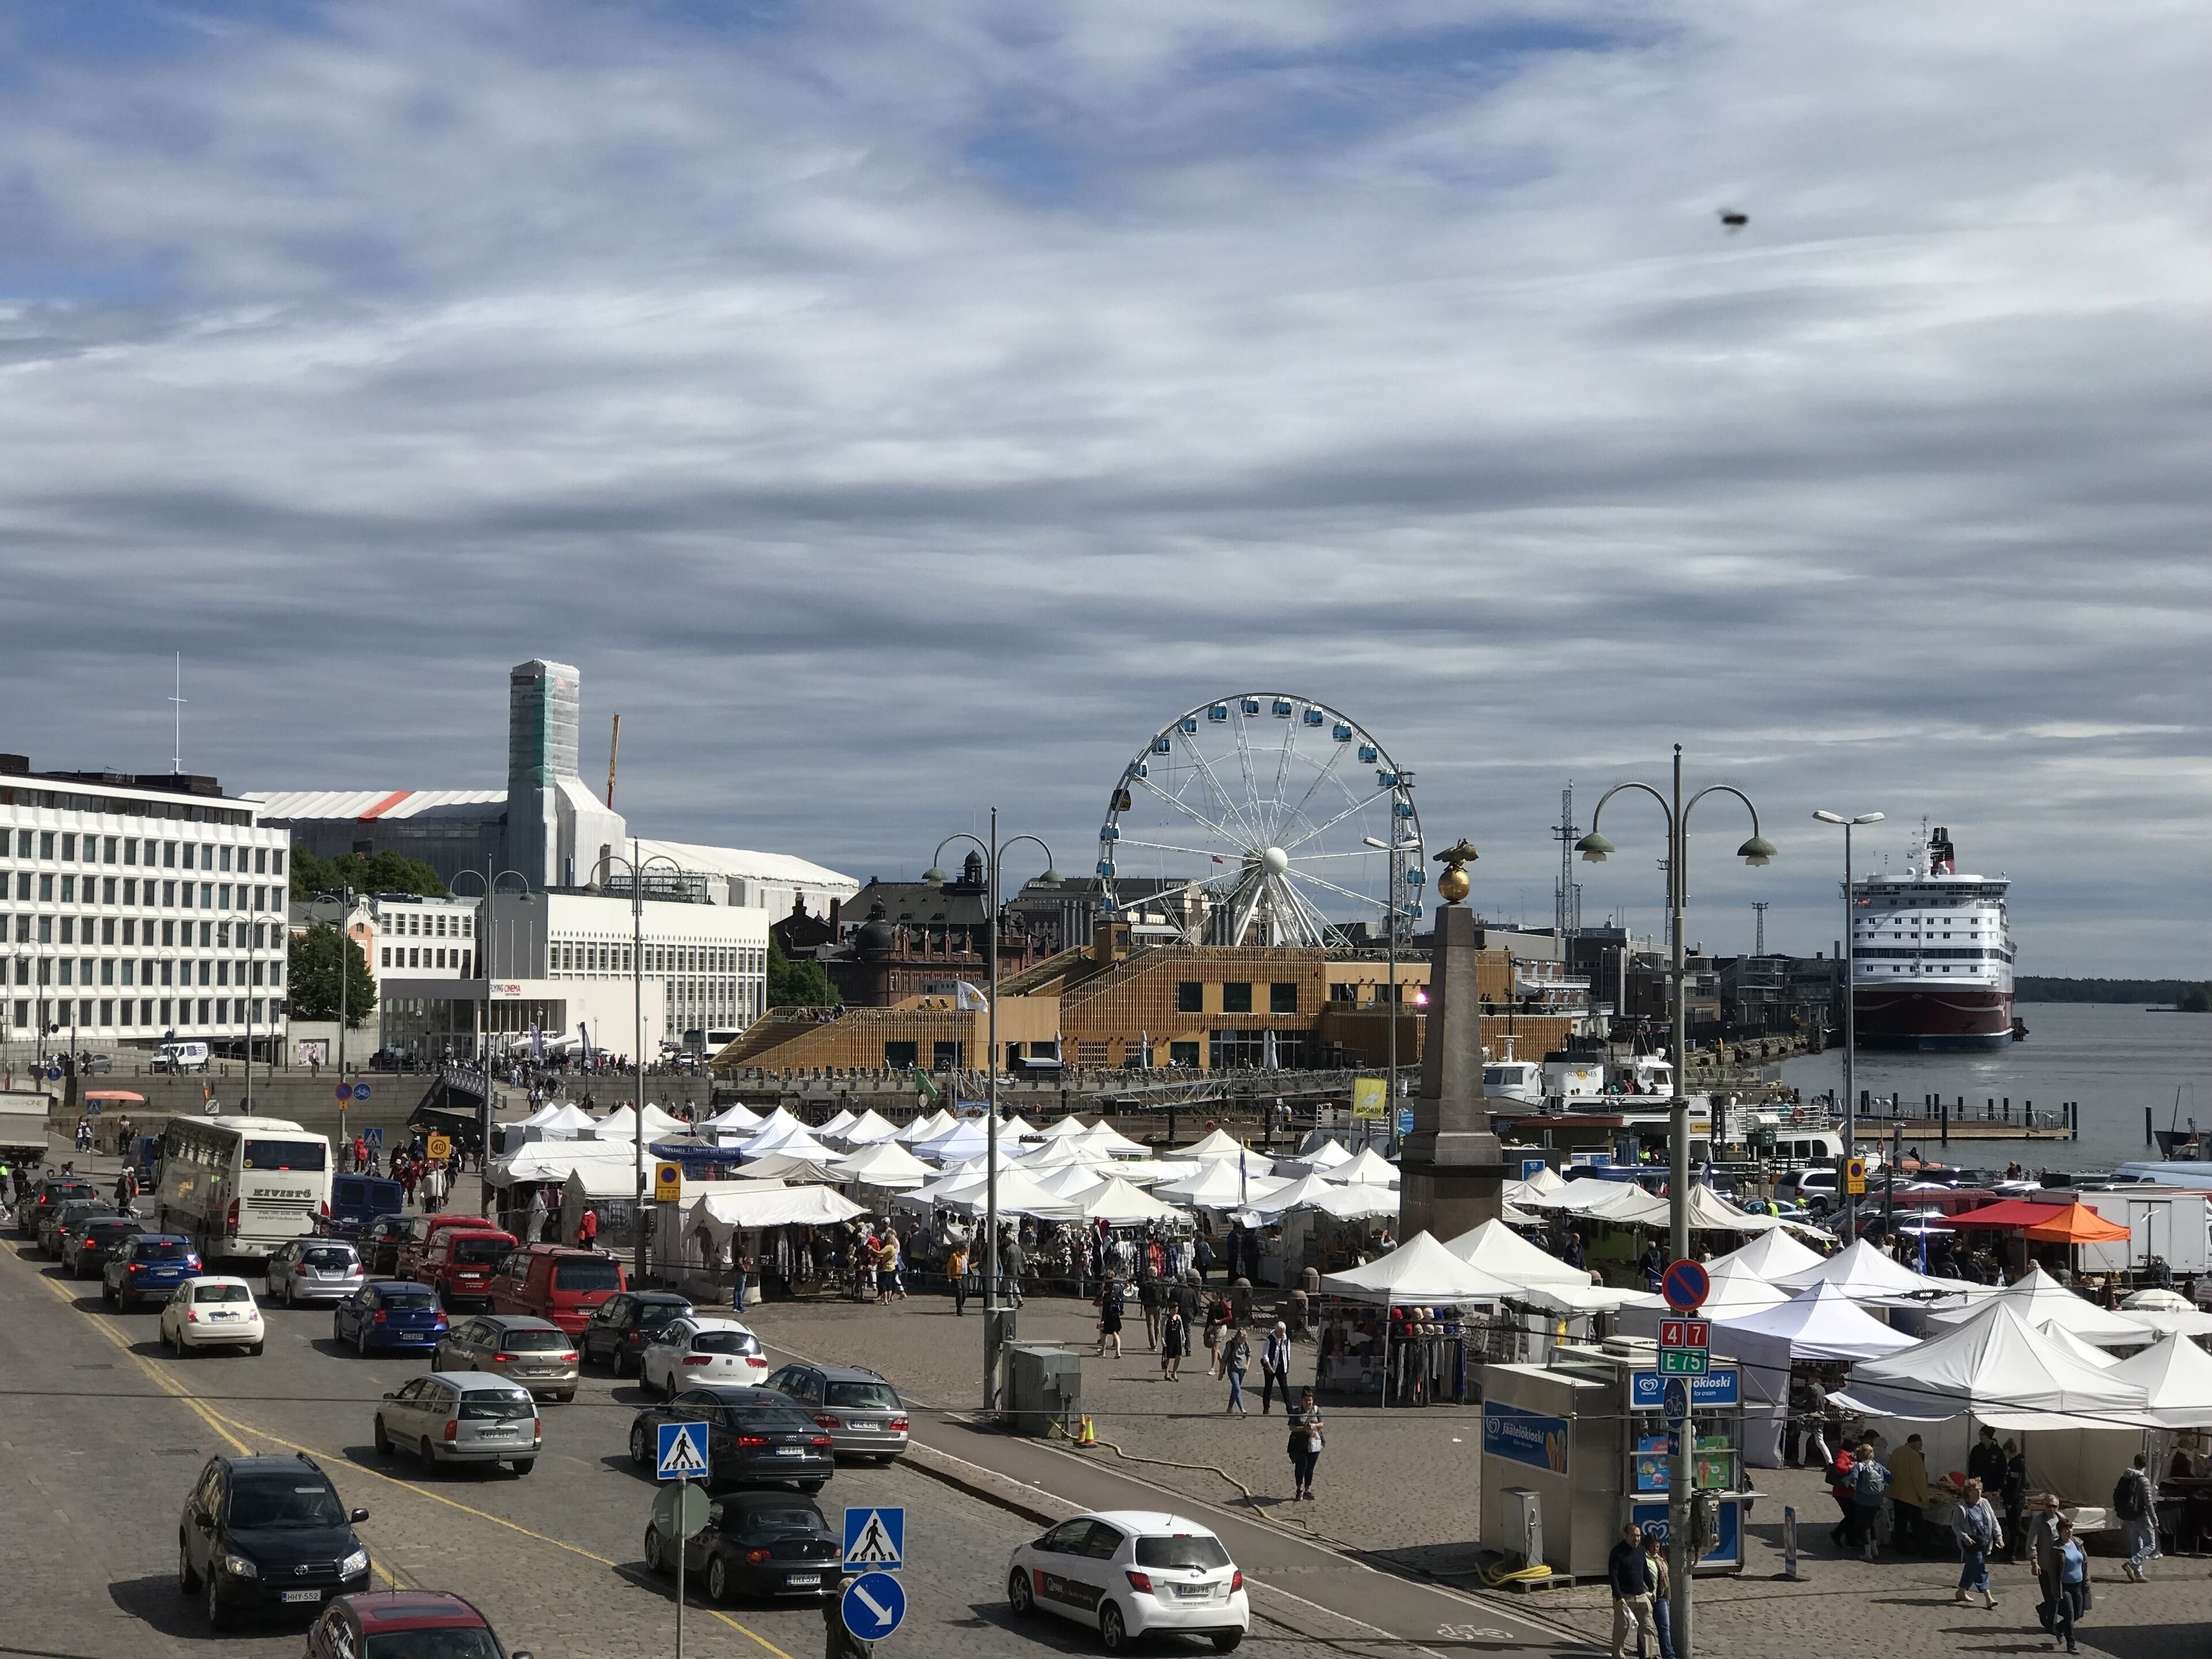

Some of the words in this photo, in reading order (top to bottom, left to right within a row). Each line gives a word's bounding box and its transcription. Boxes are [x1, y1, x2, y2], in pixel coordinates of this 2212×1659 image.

[434, 1143, 444, 1151] 40
[1667, 1325, 1677, 1343] 4
[1692, 1326, 1701, 1344] 7
[1666, 1353, 1676, 1370] E
[1681, 1353, 1700, 1370] 75
[288, 1592, 319, 1601] HHY-552
